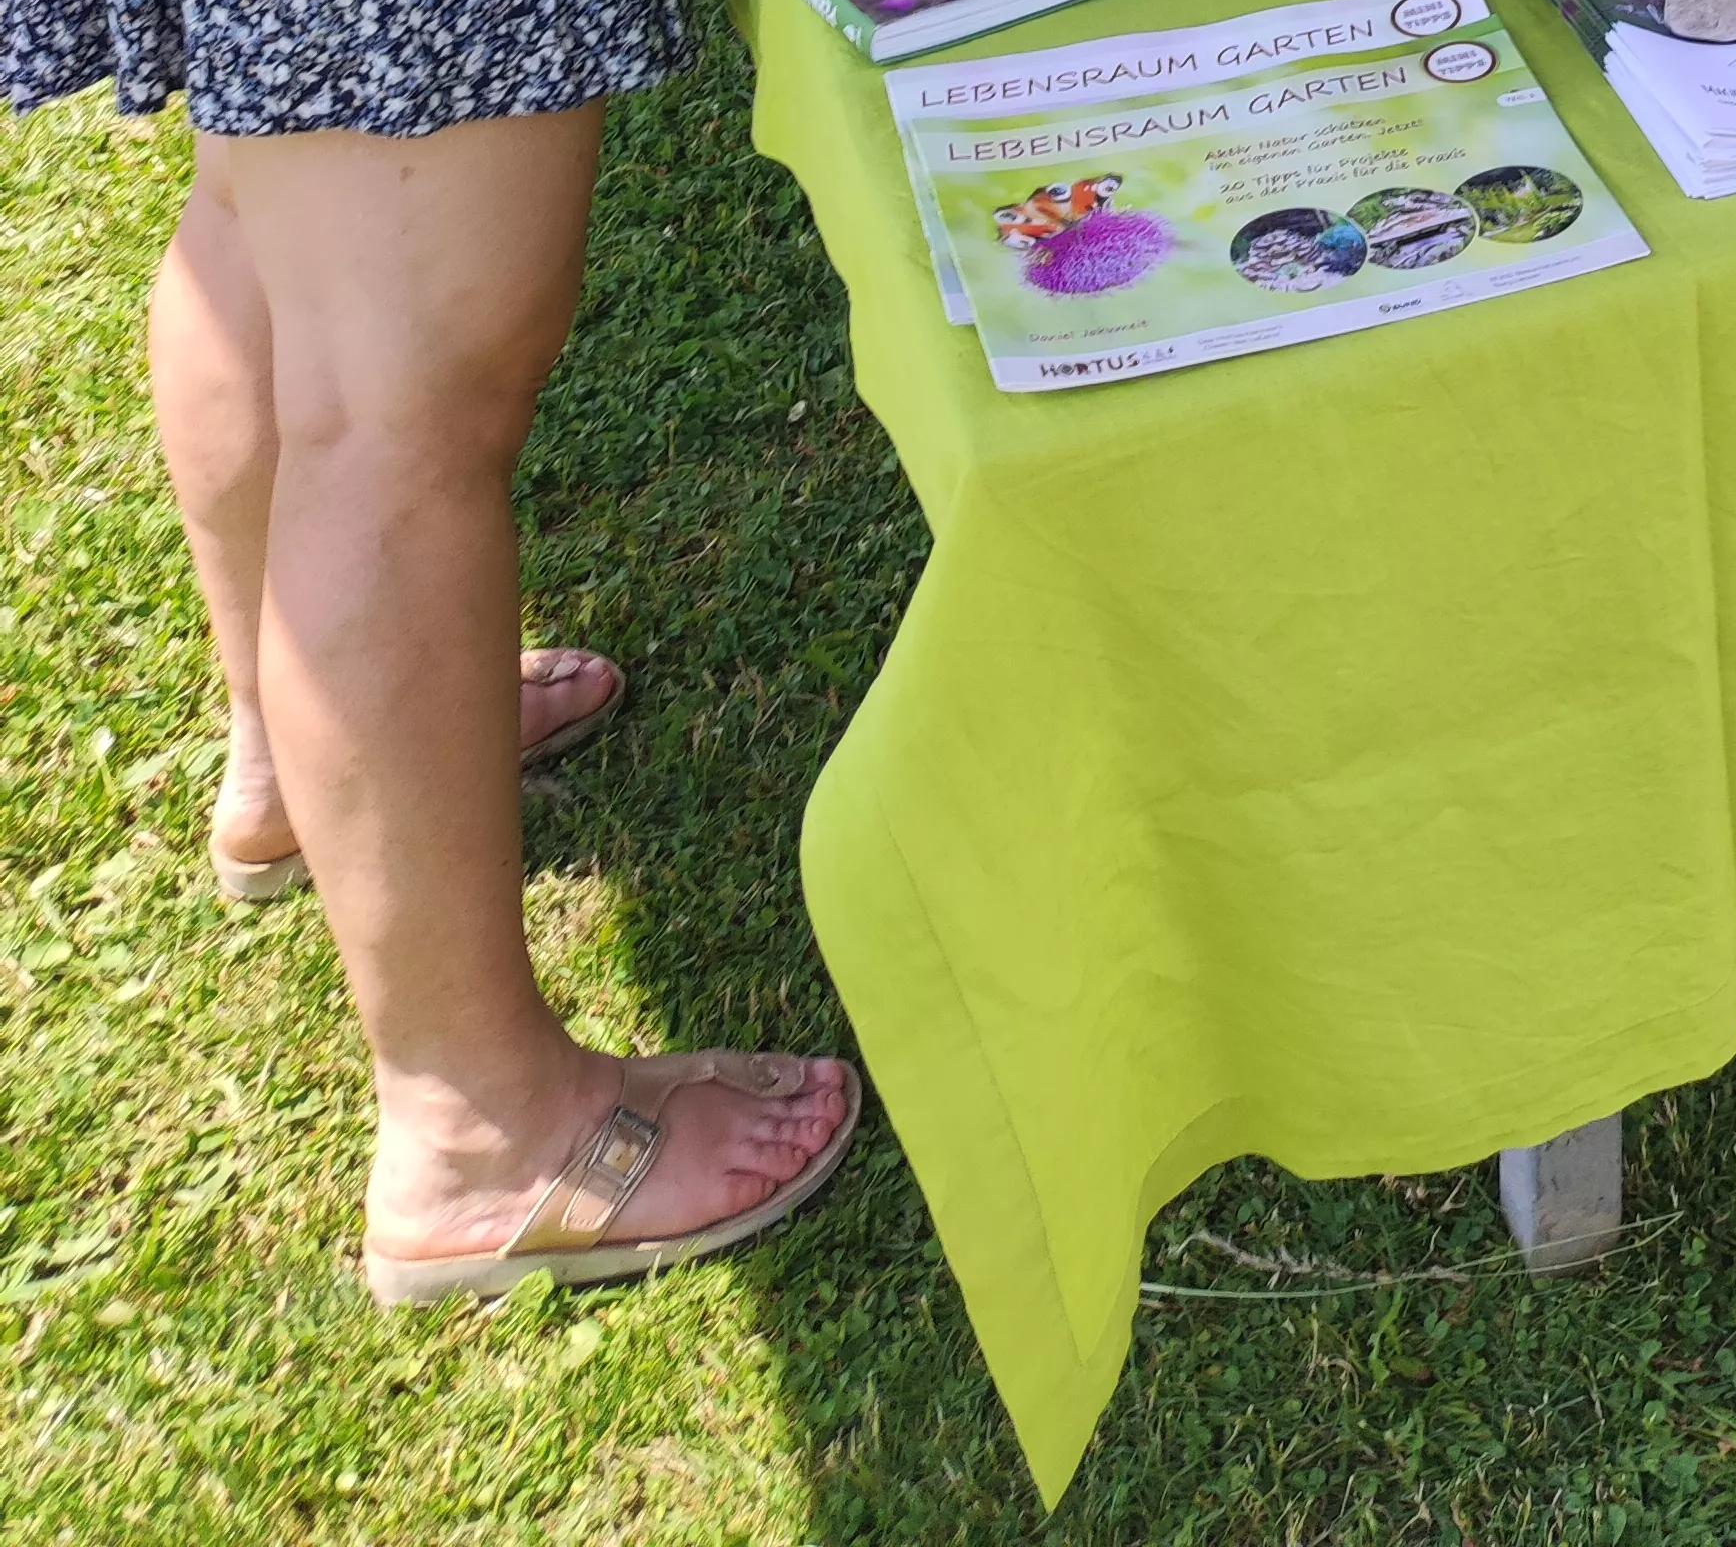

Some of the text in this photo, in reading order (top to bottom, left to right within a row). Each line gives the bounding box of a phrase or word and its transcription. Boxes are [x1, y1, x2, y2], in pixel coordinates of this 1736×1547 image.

[921, 18, 1374, 108] LEBENSRAUM GARTEN
[948, 66, 1408, 163] LEBENSRAUM GARTEN
[1204, 144, 1251, 162] Aktiv
[1258, 133, 1310, 152] Natur
[1208, 159, 1233, 171] im
[1238, 147, 1301, 167] eigenen
[1225, 148, 1467, 205] aus der Praxis für die Praxis
[1252, 170, 1301, 187] Tipps
[1306, 162, 1332, 174] für
[1339, 148, 1409, 168] Projekte
[1040, 351, 1140, 379] HORTUS
